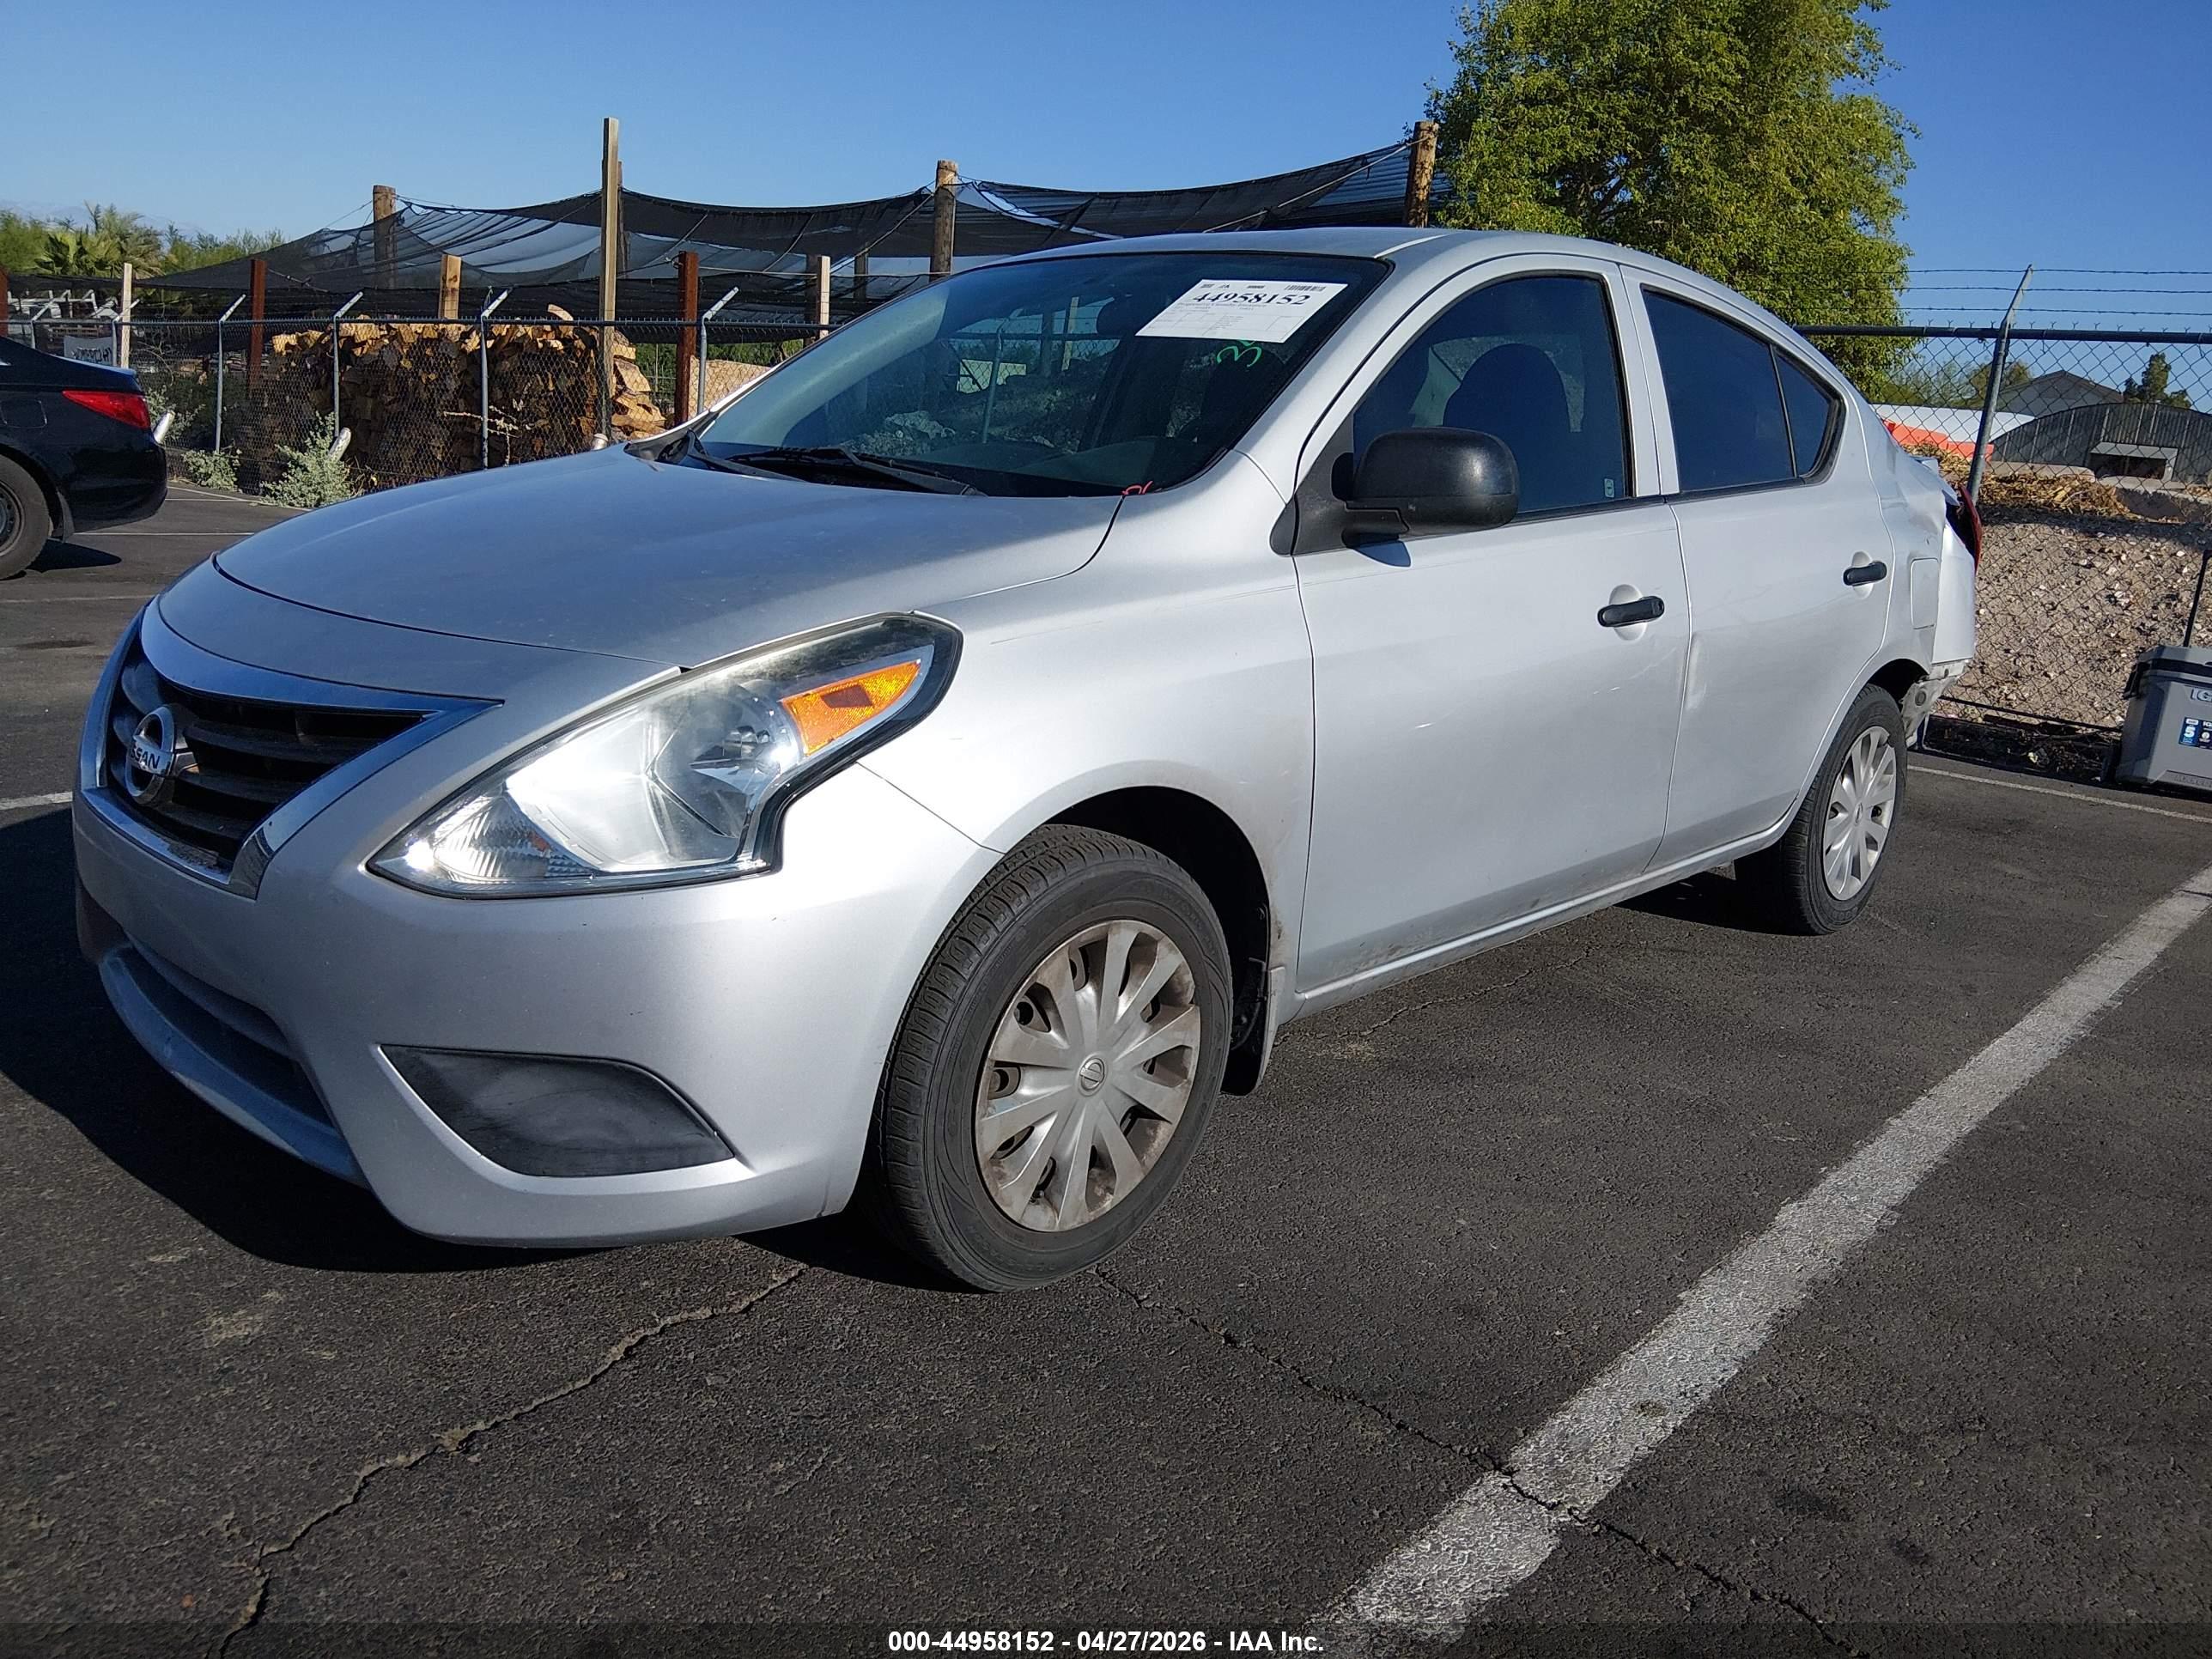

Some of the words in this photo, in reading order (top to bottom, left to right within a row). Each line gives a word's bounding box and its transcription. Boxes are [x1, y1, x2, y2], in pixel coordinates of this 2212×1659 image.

[1193, 292, 1310, 305] 44958152
[2184, 726, 2196, 738] 5
[129, 744, 161, 769] SSAN
